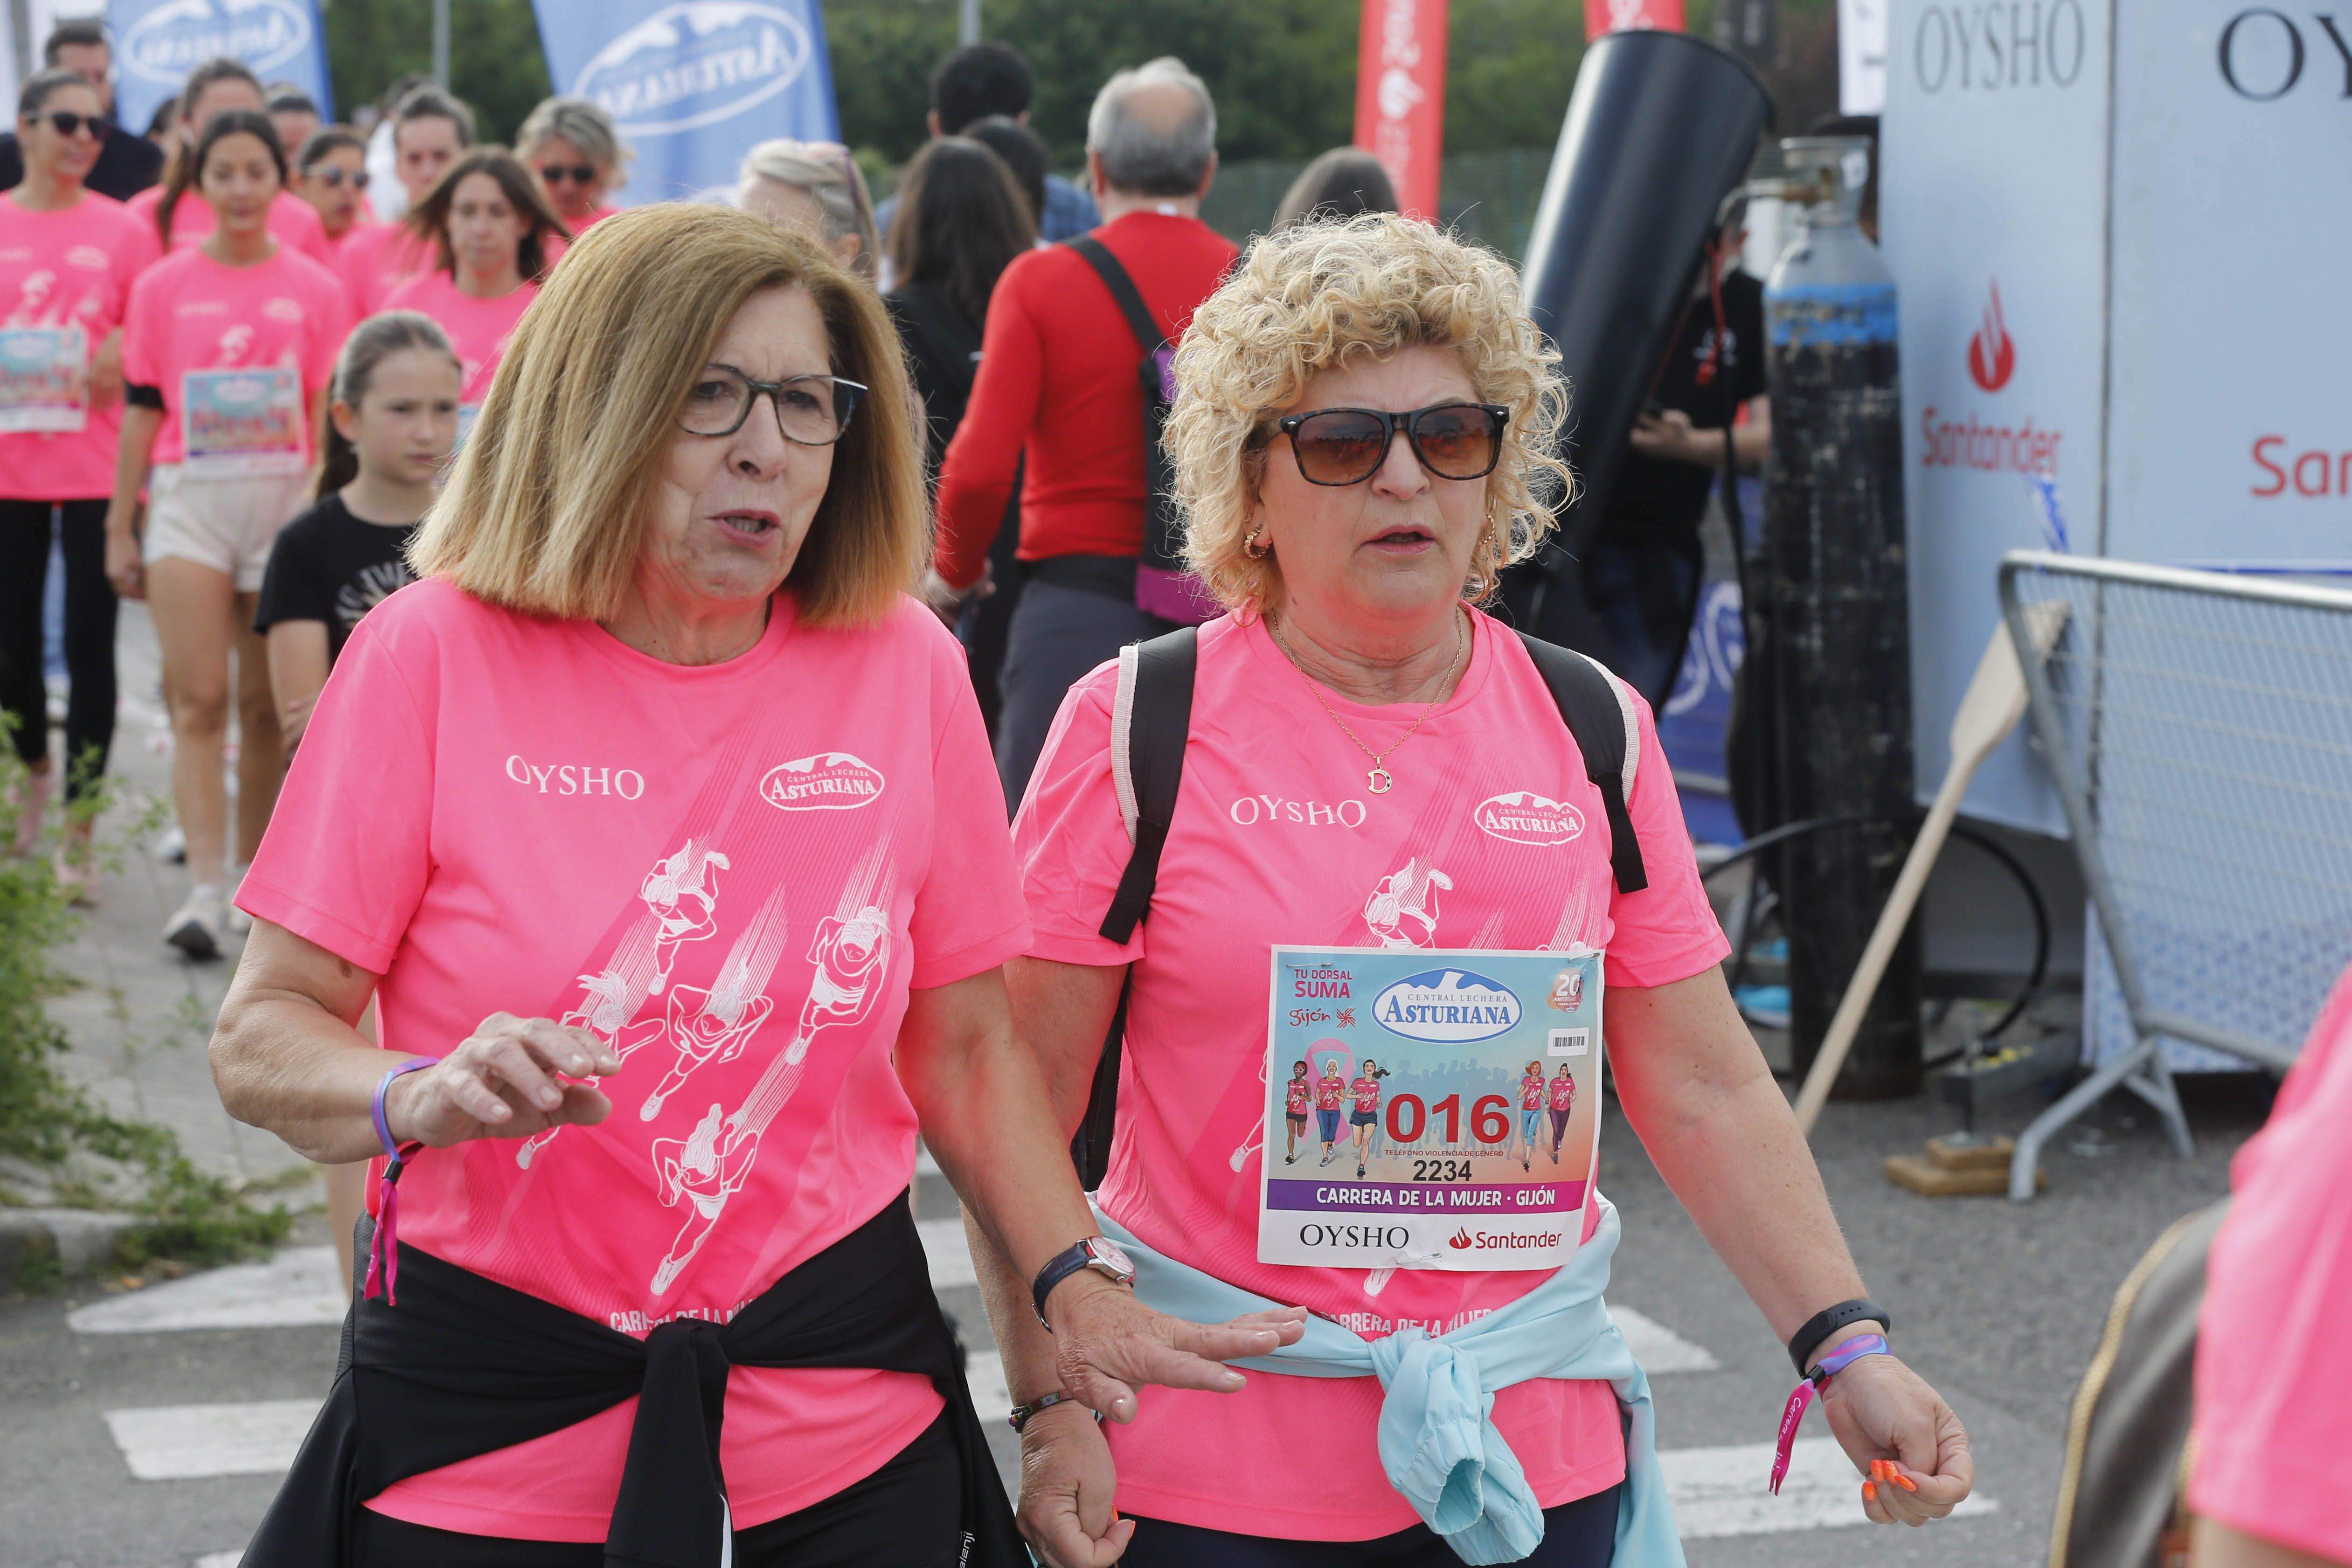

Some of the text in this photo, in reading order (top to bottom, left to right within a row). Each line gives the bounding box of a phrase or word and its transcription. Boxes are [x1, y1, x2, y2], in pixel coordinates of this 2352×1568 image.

[1914, 0, 2085, 94] OYSHO
[1921, 406, 2061, 474] Santander
[506, 755, 645, 800] OYSHO
[770, 777, 877, 799] ASTURIANA
[787, 769, 869, 783] CENTRAL LECHERA
[1231, 794, 1366, 828] OYSHO
[1485, 809, 1580, 834] ASTURIANA
[1295, 969, 1352, 980] TU DORSAL
[1556, 974, 1580, 996] 20
[1295, 981, 1350, 998] SUMA
[1290, 1008, 1331, 1027] gijón
[1383, 995, 1511, 1024] ASTURIANA
[1386, 1093, 1510, 1144] 016
[1413, 1160, 1472, 1181] 2234
[1316, 1186, 1555, 1207] CARRERA DE LA MUJER GIJÓN
[1299, 1224, 1562, 1249] OYSHO Santander
[1781, 1397, 1801, 1434] Carrera
